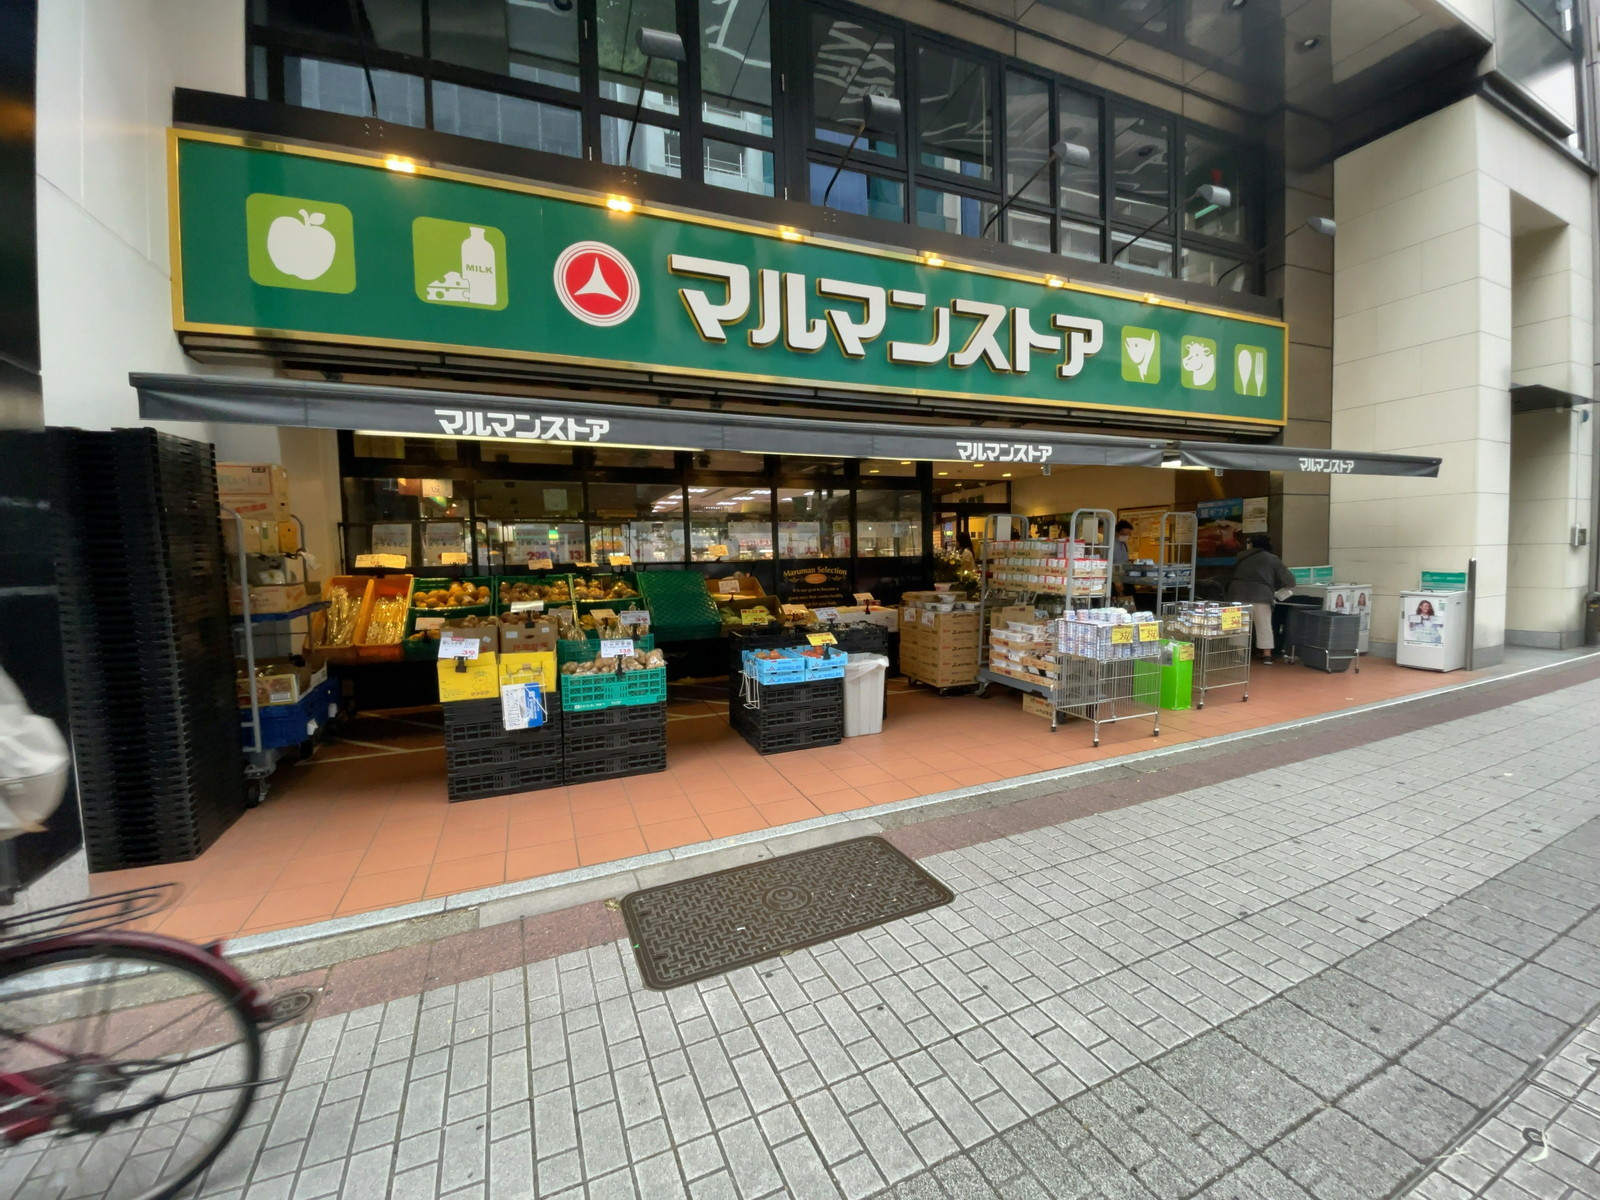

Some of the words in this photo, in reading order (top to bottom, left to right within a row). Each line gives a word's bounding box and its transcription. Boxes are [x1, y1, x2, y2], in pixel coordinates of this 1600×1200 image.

[466, 263, 493, 274] MILK
[668, 253, 1104, 378] マルマンストア
[434, 409, 610, 442] マルマンストア
[956, 441, 1053, 463] マルマンストア
[1298, 457, 1354, 473] マルマンストア
[783, 568, 816, 577] Maruman
[817, 566, 847, 576] Selection
